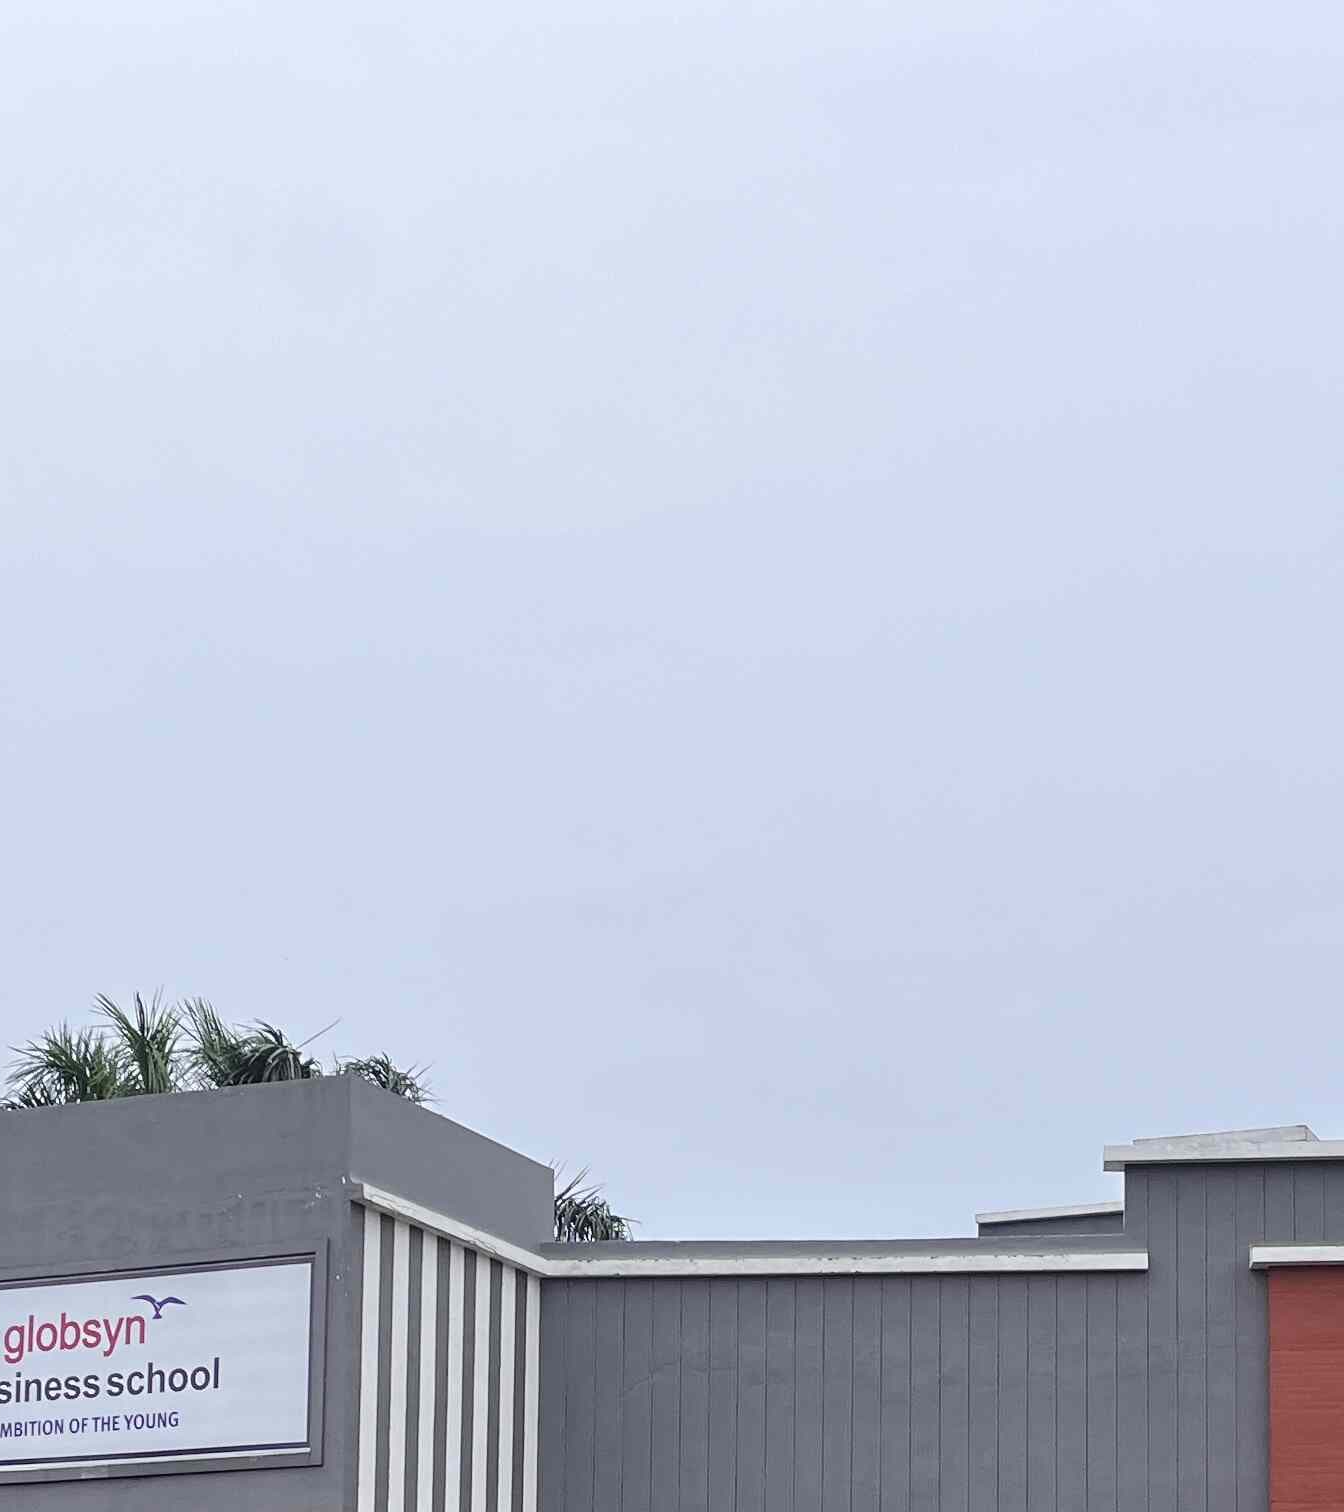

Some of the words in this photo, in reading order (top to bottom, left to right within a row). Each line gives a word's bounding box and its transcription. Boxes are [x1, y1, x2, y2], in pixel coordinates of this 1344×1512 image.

[3, 1312, 147, 1364] globsyn
[106, 1357, 221, 1398] school
[68, 1417, 89, 1435] OF
[92, 1414, 121, 1433] THE
[123, 1411, 180, 1431] YOUNG
